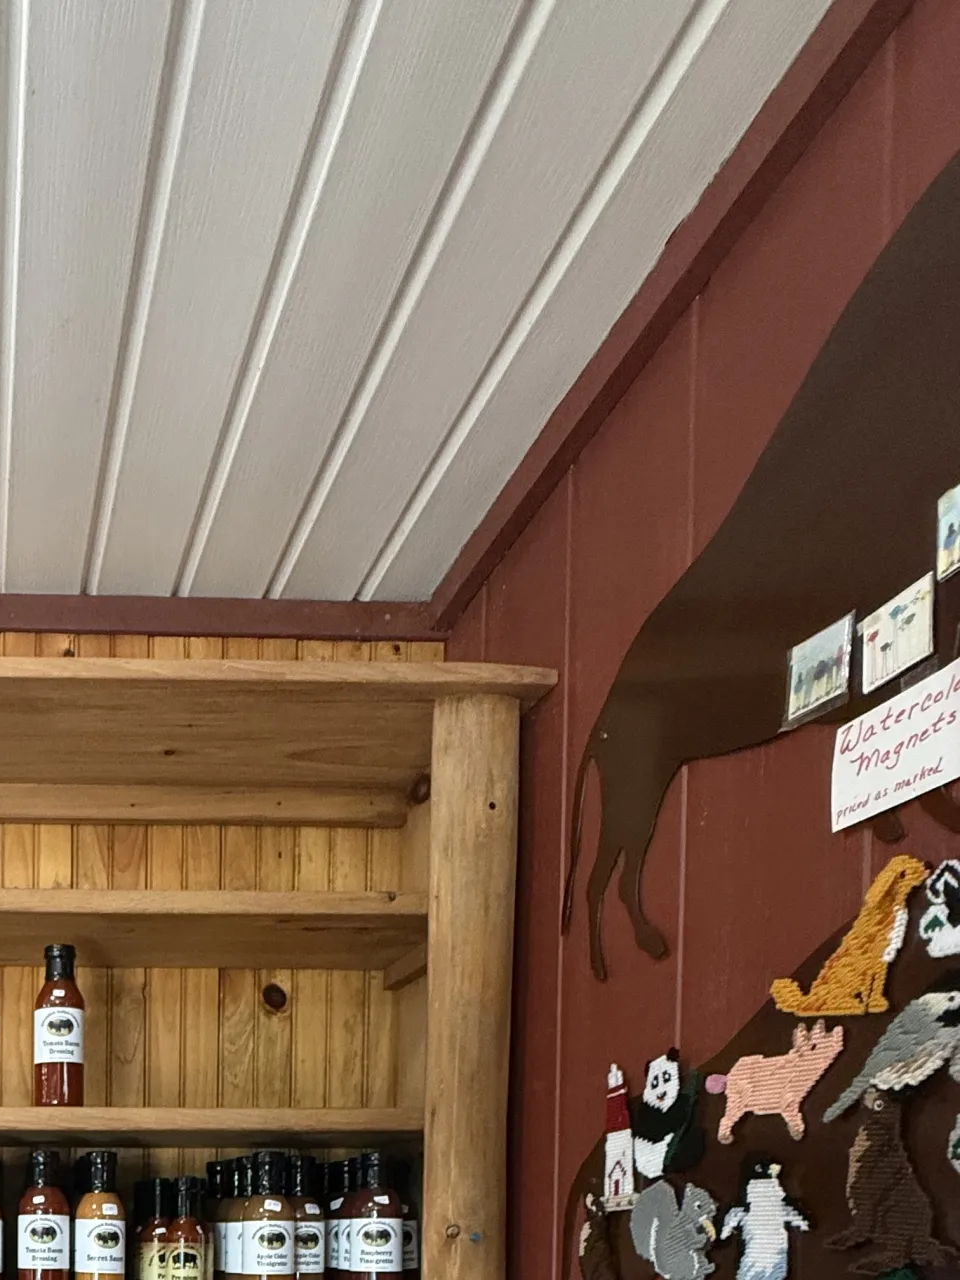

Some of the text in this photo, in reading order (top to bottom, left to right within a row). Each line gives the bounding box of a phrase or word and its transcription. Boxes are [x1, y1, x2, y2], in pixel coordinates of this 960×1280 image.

[850, 709, 957, 777] Magnets
[835, 756, 944, 826] priced as marked
